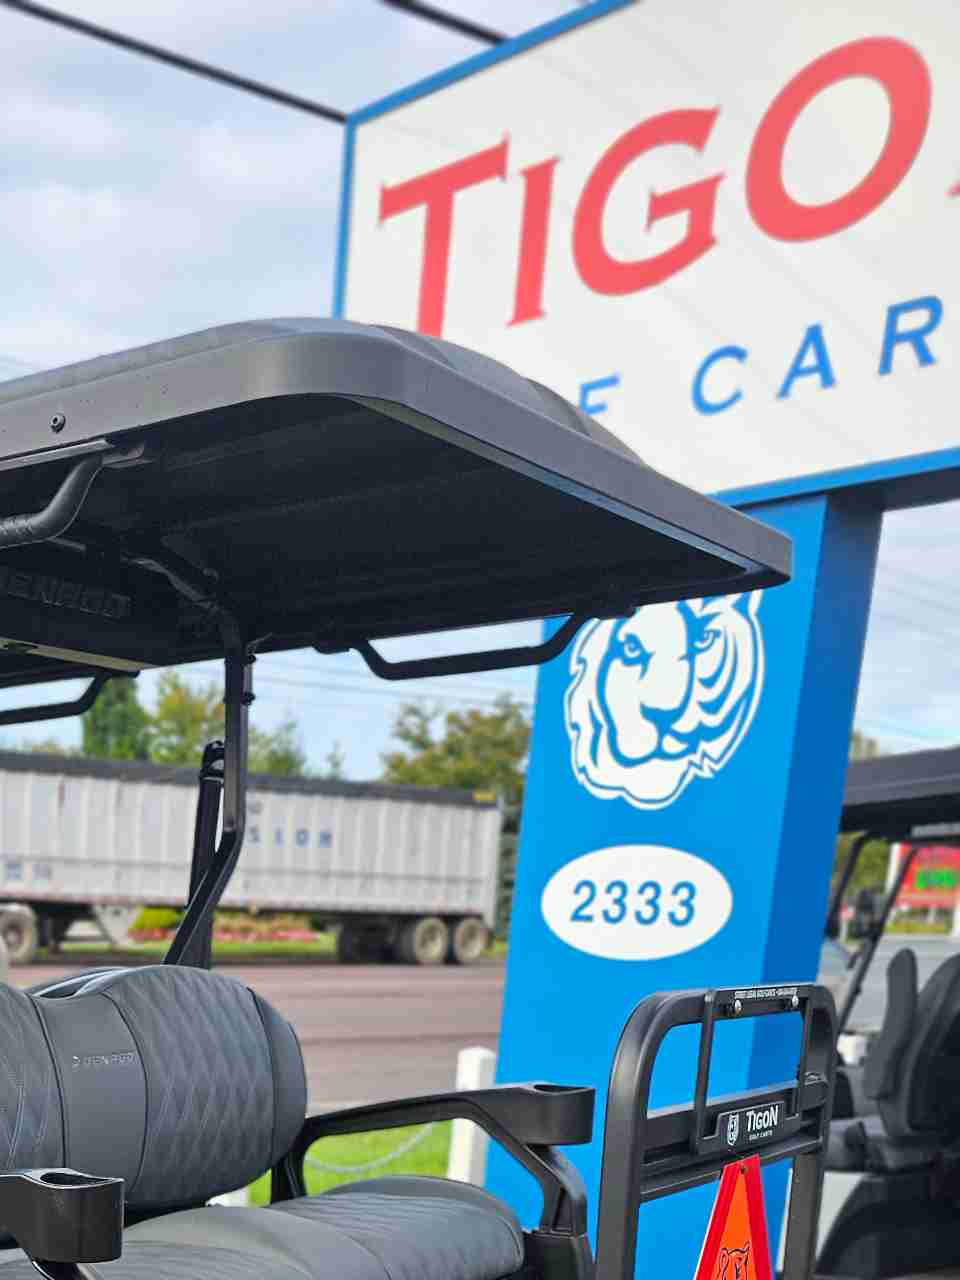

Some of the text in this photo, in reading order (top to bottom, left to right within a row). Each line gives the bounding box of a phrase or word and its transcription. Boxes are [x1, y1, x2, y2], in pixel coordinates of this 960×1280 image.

[379, 36, 960, 338] TIGO
[569, 879, 697, 927] 2333
[746, 1104, 779, 1132] TIGON
